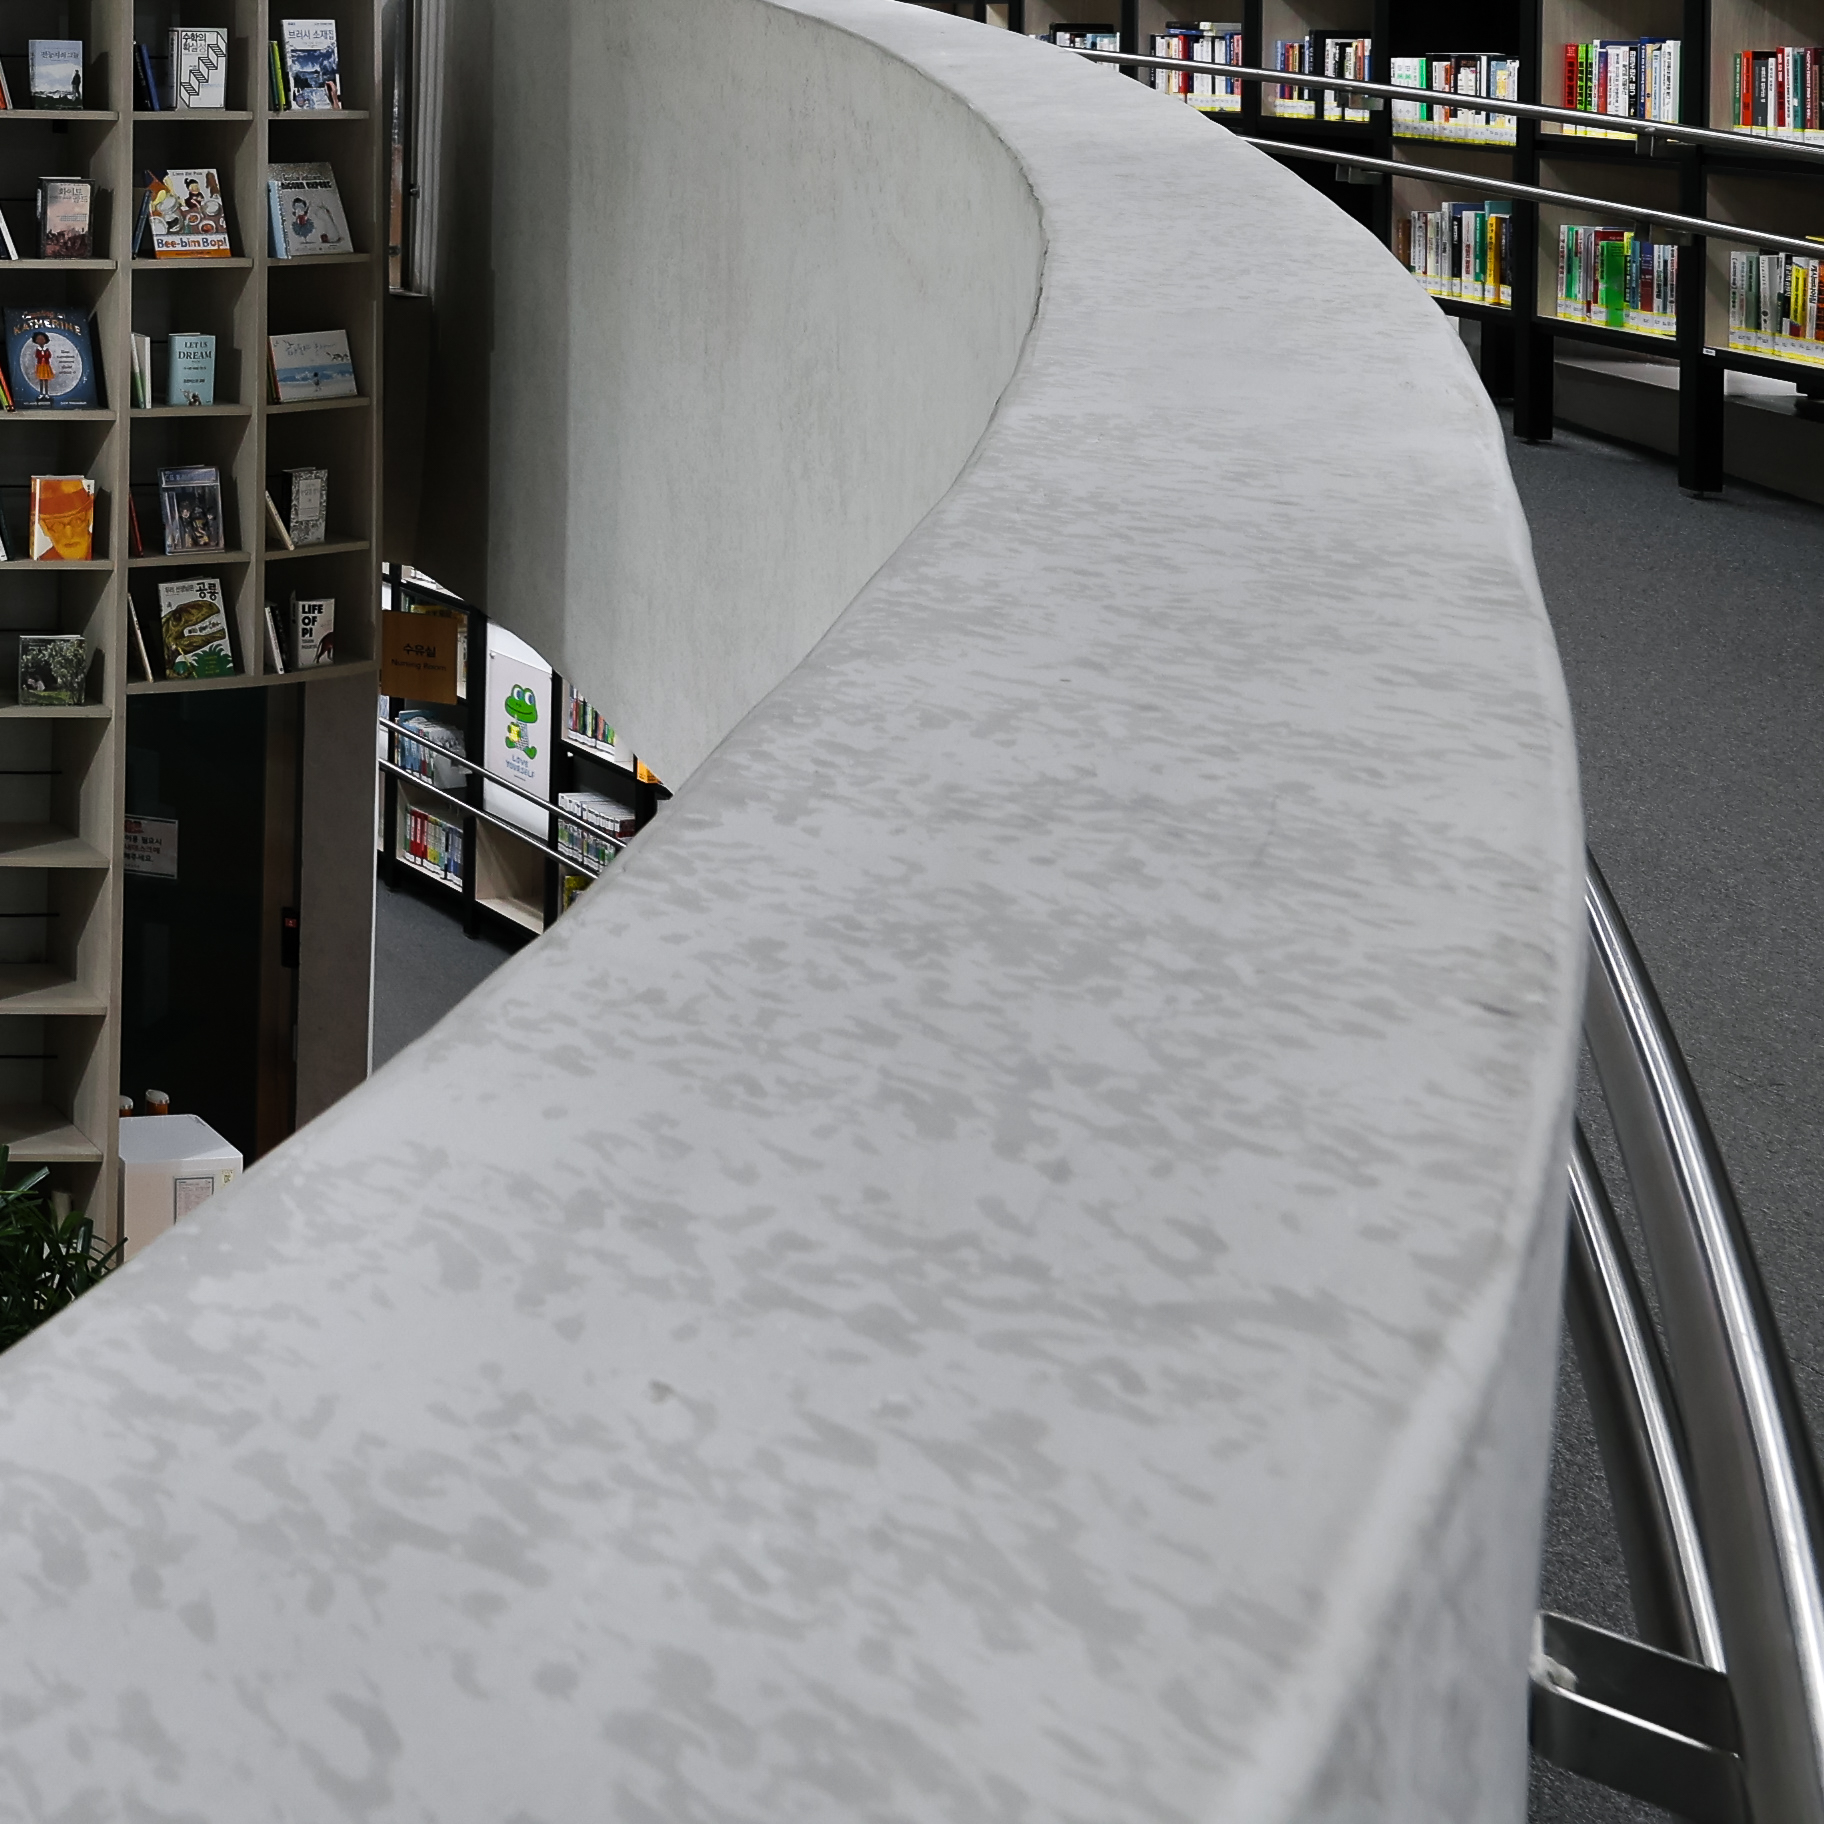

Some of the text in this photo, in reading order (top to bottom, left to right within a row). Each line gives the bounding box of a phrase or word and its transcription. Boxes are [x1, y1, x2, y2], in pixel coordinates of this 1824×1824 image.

[182, 32, 207, 44] 수학의
[287, 29, 334, 40] 브러시 소재집
[157, 237, 228, 249] Bee-bim Bop!
[13, 319, 82, 336] KATHERINE
[184, 341, 199, 349] LET
[178, 350, 212, 360] DREAM
[175, 584, 194, 592] 선생님은
[195, 581, 219, 601] 공룡
[301, 604, 323, 614] LIFE
[301, 615, 318, 626] OF
[301, 627, 313, 638] PI
[403, 643, 436, 657] 수유실
[391, 659, 446, 671] Nursing Room
[512, 754, 528, 769] LOVE
[505, 759, 534, 779] YOURSELF
